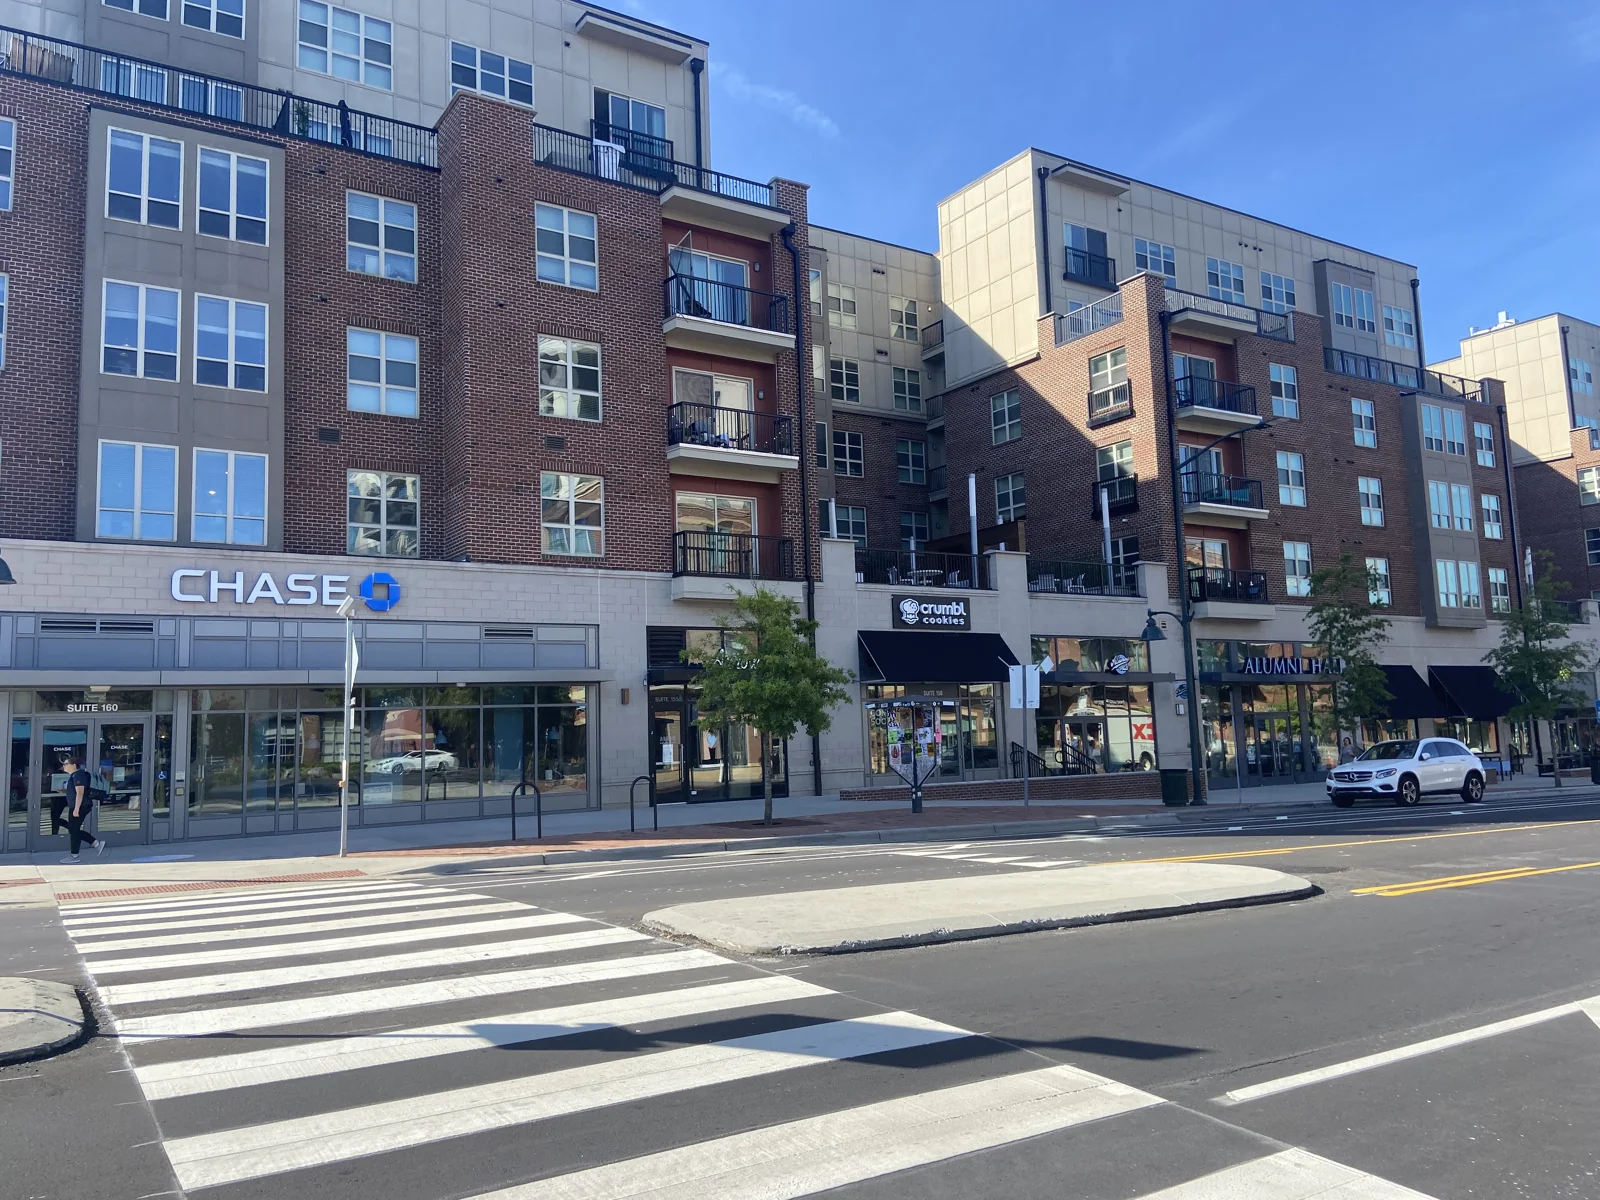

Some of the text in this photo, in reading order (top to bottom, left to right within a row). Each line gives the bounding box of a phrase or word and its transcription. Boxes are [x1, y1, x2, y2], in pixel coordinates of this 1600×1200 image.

[171, 569, 350, 606] CHASE
[920, 602, 967, 616] crumbl
[922, 616, 965, 625] cookies
[1244, 656, 1303, 674] ALUMNI
[67, 704, 118, 712] SUITE 160
